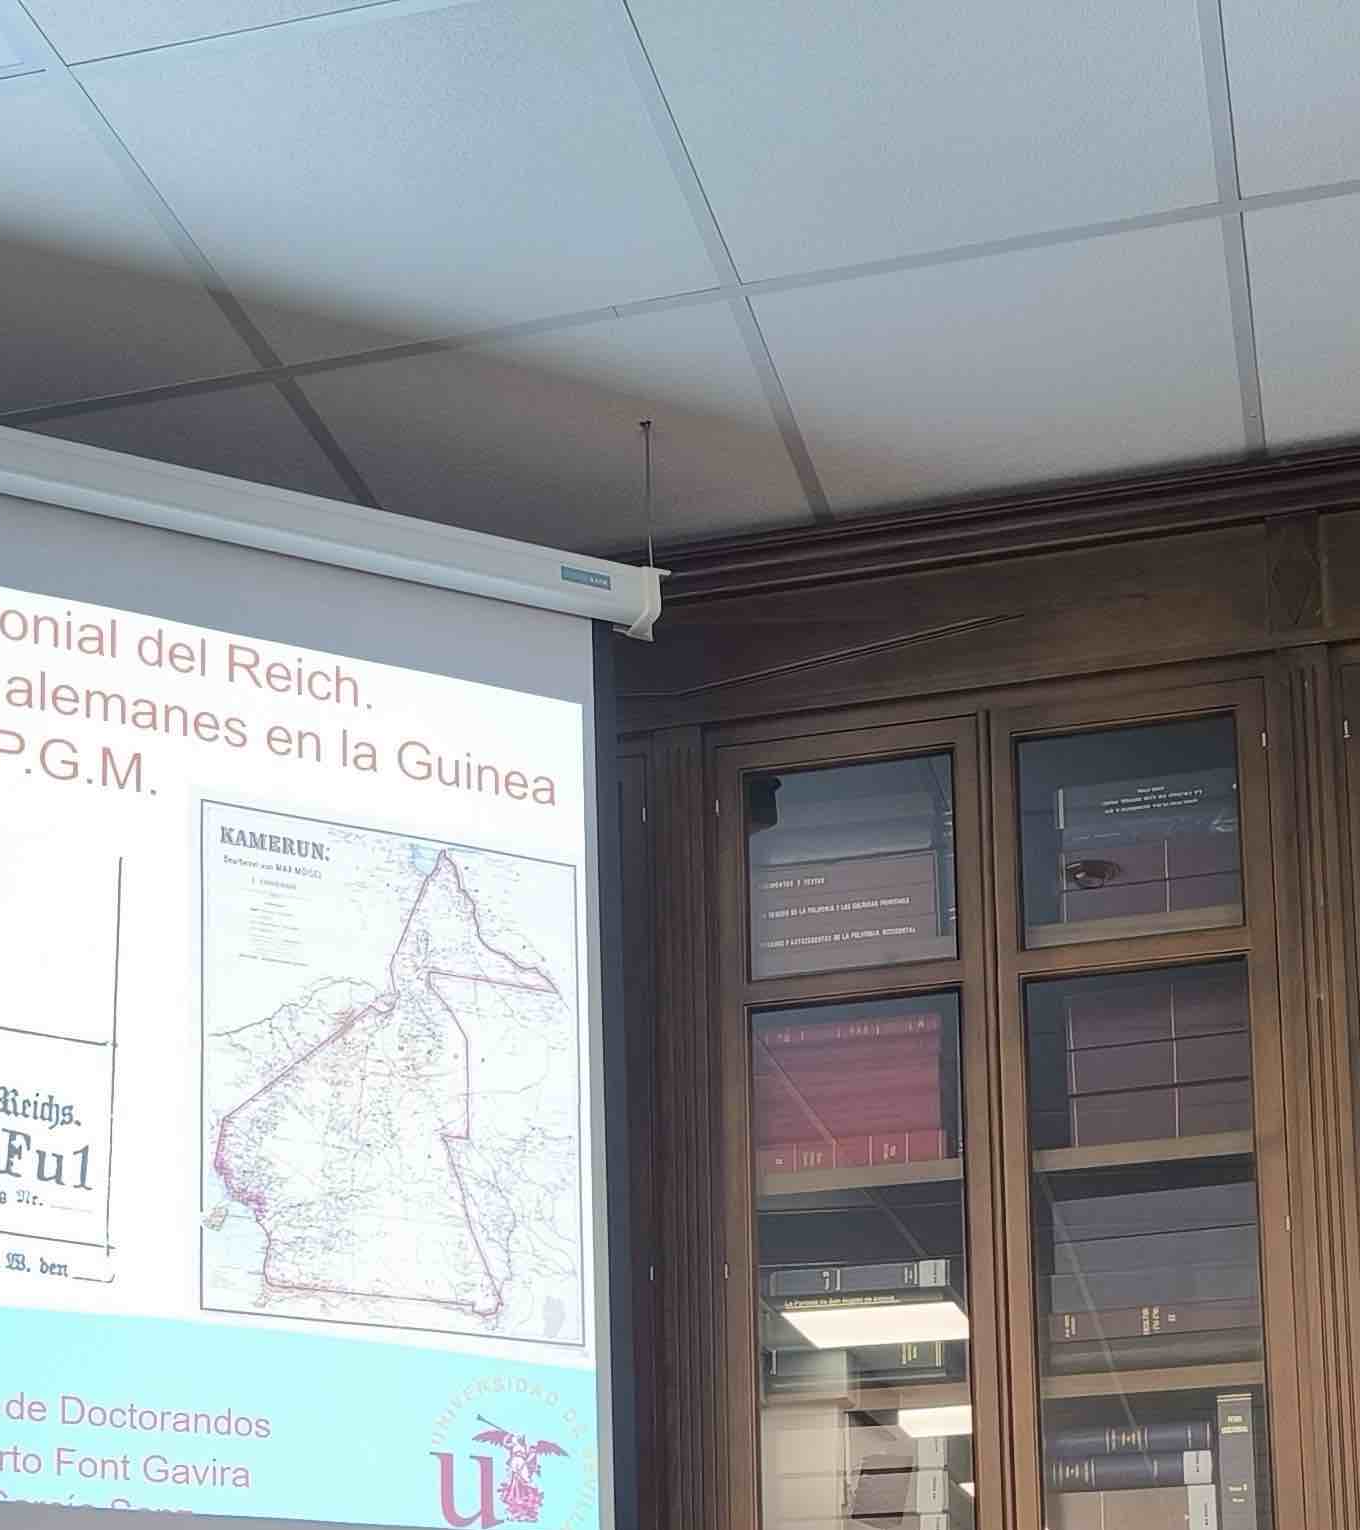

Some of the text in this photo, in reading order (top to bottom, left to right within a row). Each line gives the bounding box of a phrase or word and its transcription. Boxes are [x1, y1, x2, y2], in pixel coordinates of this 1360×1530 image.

[136, 625, 207, 679] del
[227, 642, 375, 710] Reich.
[5, 671, 248, 749] alemanes
[265, 722, 322, 762] en
[339, 717, 378, 771] la
[399, 739, 556, 807] Guinea
[39, 1256, 69, 1279] den
[5, 1391, 49, 1423] de
[60, 1394, 272, 1440] Doctorandos
[54, 1447, 132, 1482] Font
[142, 1454, 252, 1490] Gavira
